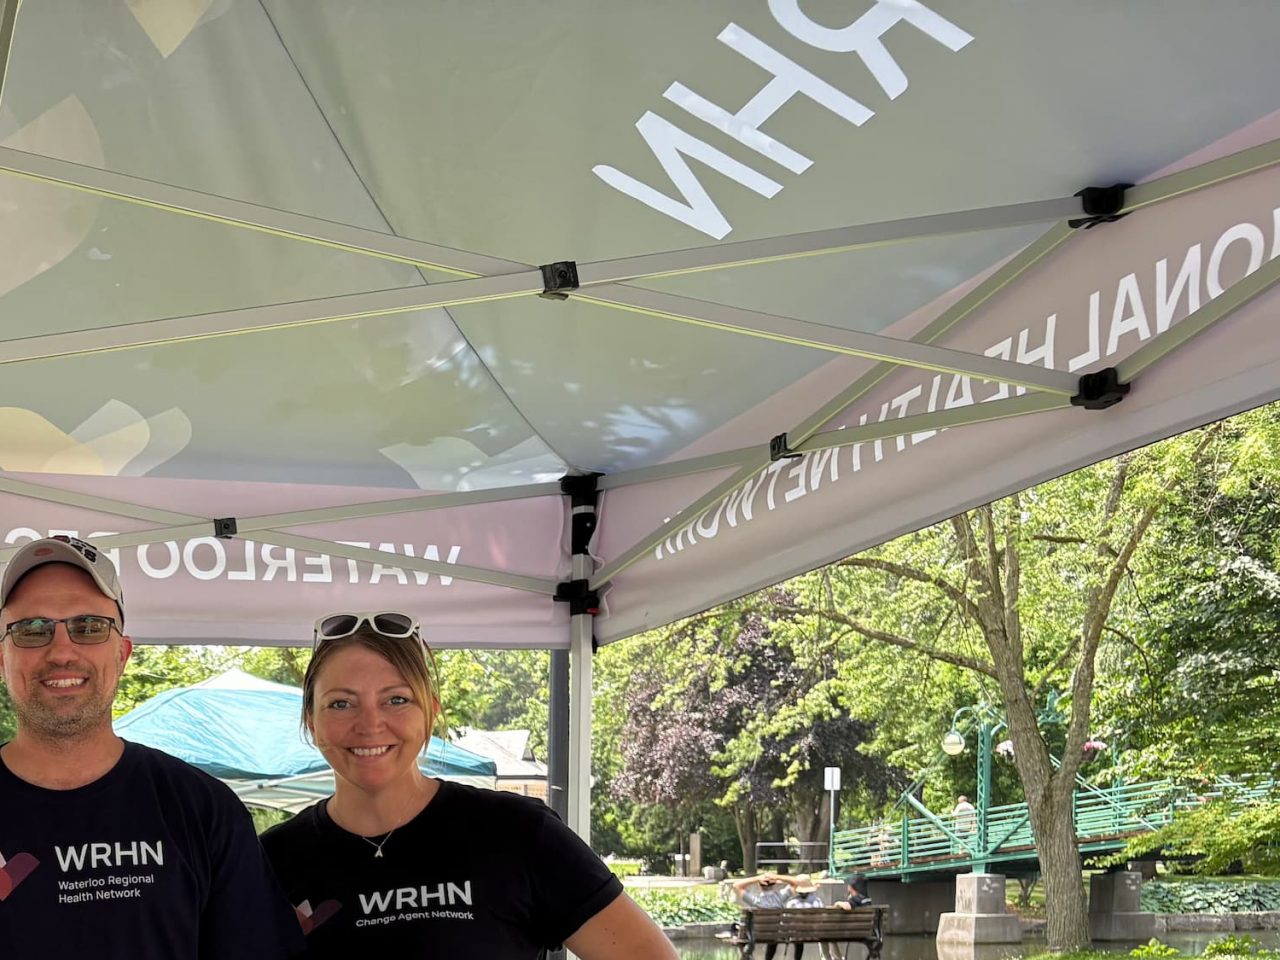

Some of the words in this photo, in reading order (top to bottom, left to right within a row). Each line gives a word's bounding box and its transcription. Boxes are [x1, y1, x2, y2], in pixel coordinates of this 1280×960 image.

[54, 840, 165, 873] WRHN
[57, 877, 106, 891] Waterloo
[108, 873, 154, 887] Regional
[58, 890, 94, 904] Health
[96, 887, 141, 900] Network
[358, 880, 473, 915] WRHN
[356, 915, 396, 927] Change
[397, 911, 430, 922] Agent
[431, 909, 474, 921] Network
